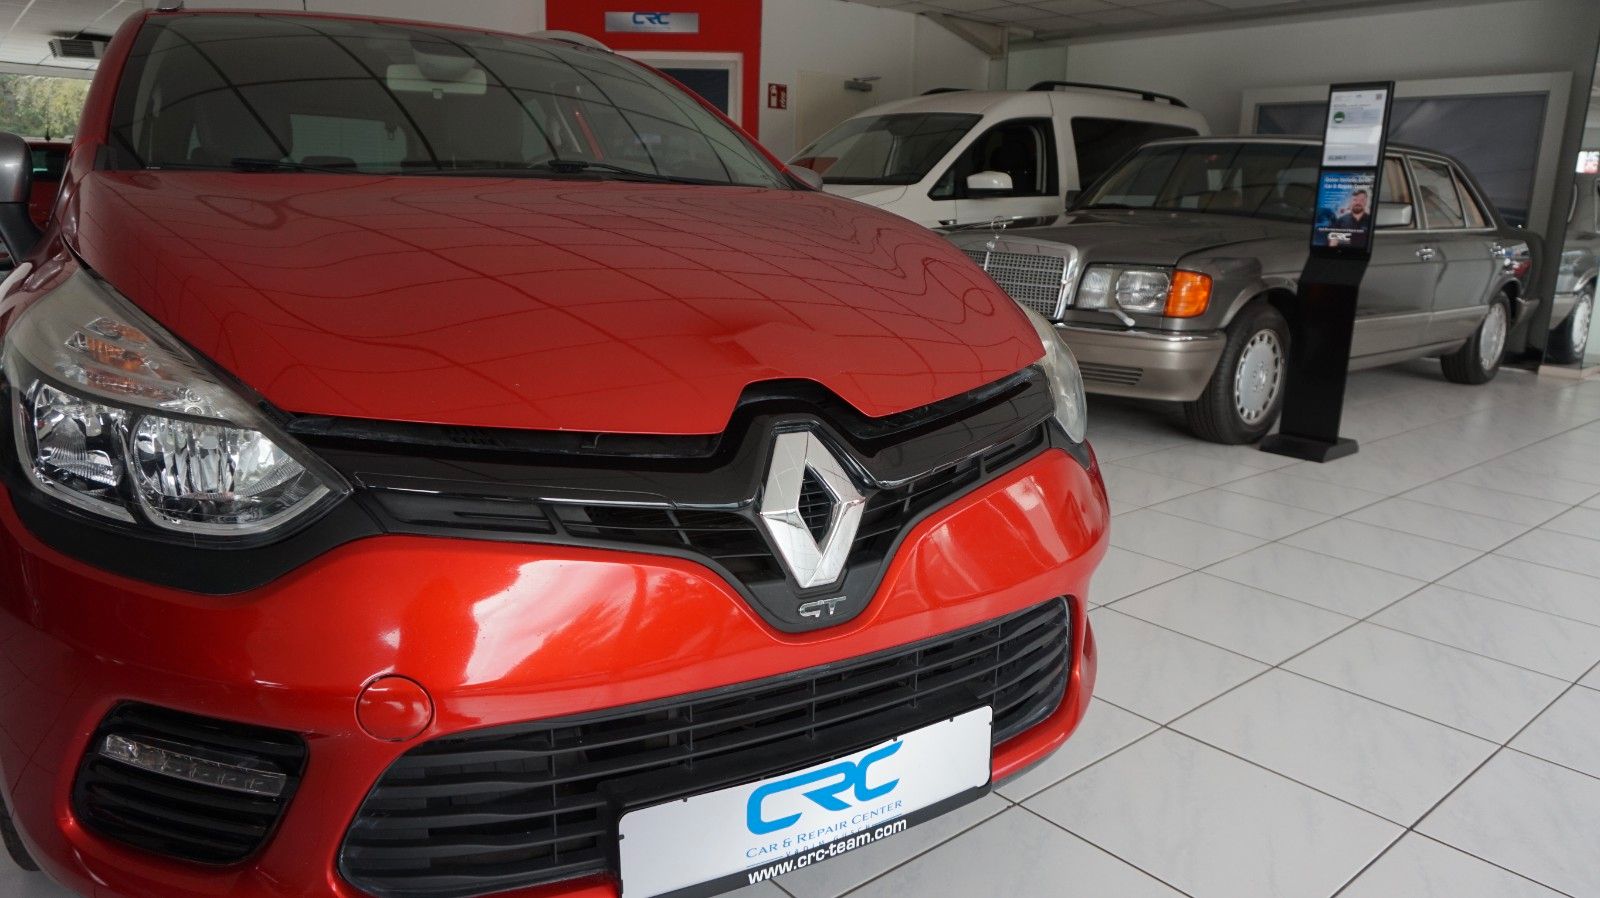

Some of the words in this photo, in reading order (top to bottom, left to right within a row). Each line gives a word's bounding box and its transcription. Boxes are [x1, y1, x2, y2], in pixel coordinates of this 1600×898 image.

[632, 12, 671, 25] CRC
[799, 596, 847, 618] GT
[746, 740, 904, 836] CRC
[747, 818, 907, 885] www.crc-team.com
